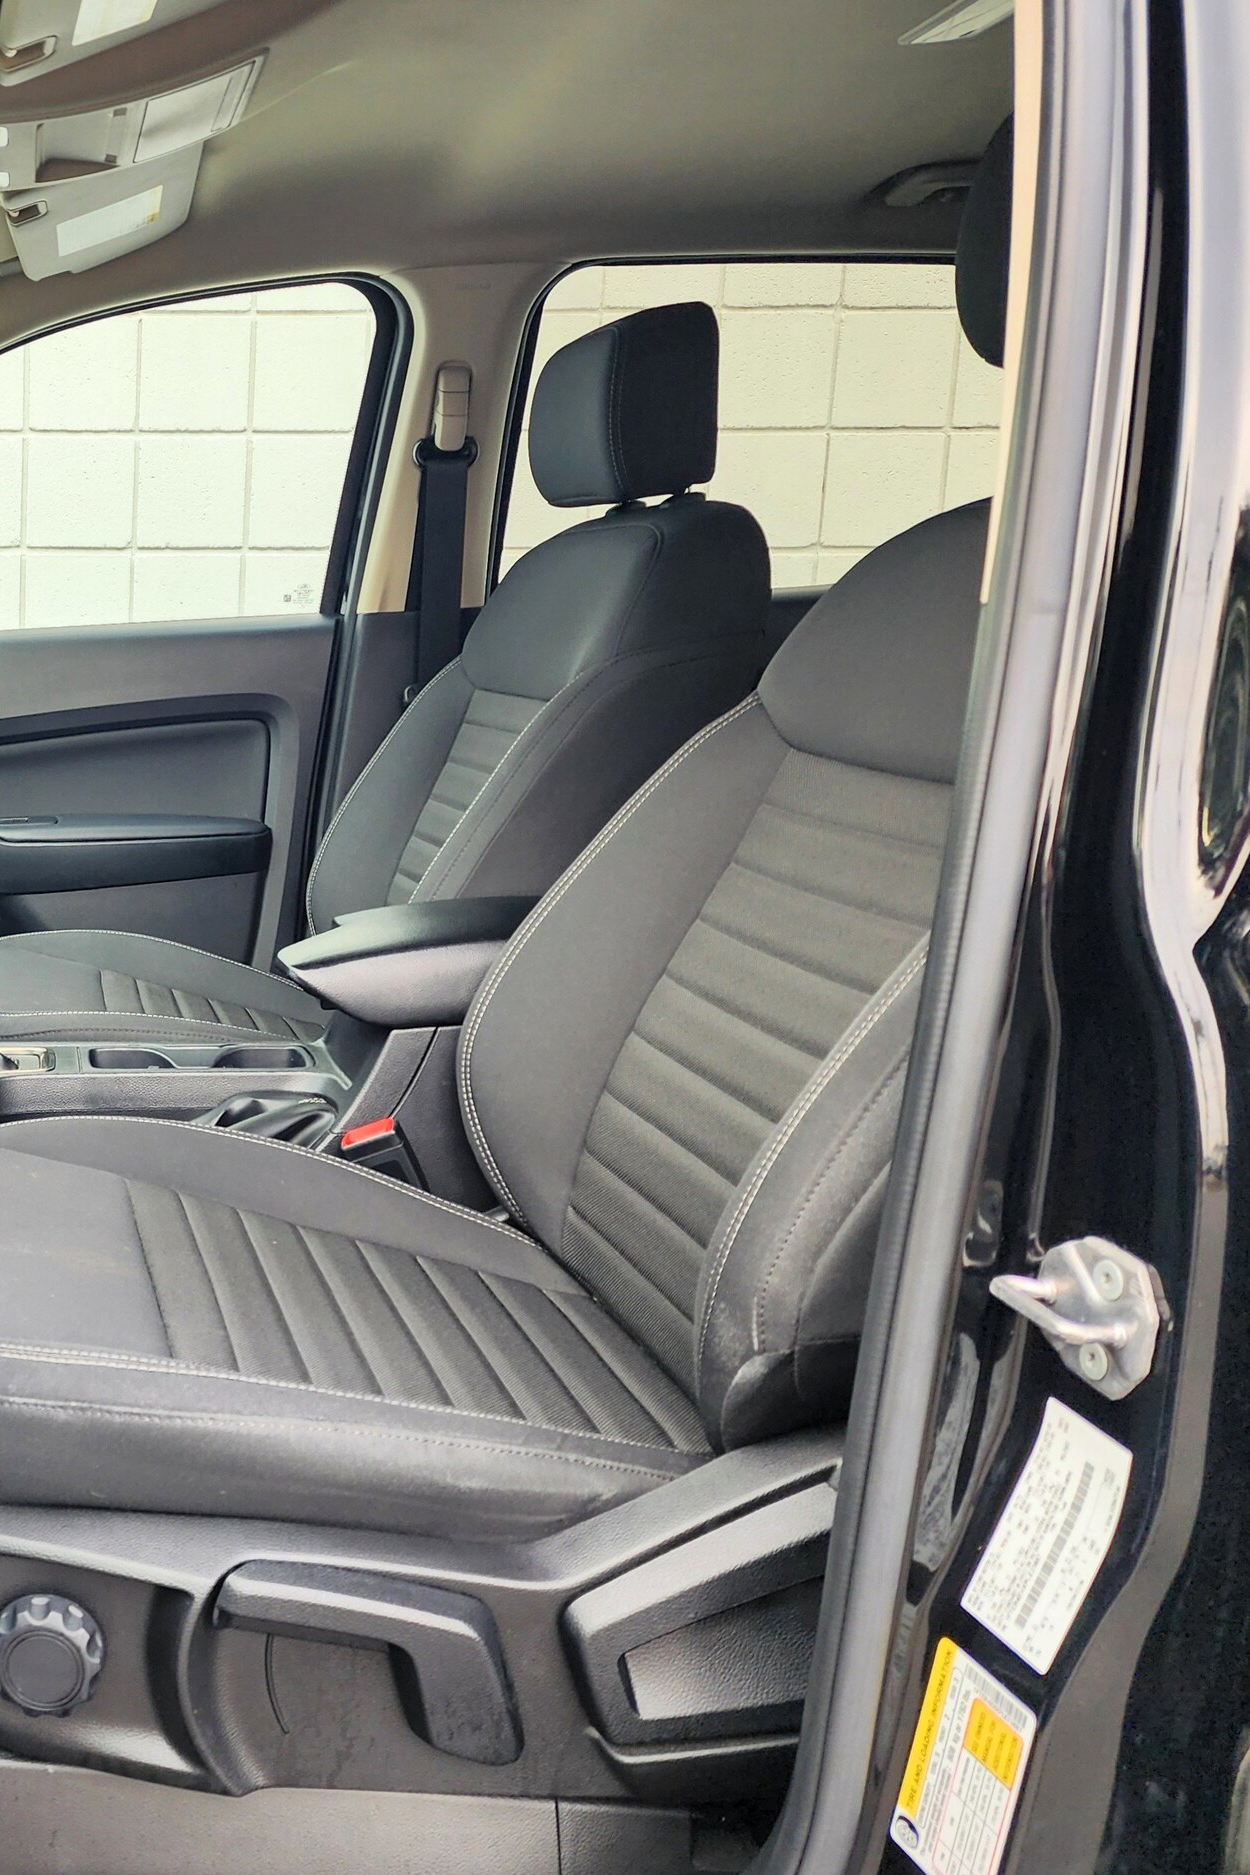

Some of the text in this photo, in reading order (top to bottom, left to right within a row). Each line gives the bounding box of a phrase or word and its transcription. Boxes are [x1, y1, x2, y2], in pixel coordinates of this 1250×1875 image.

[906, 1785, 917, 1810] TIRE
[914, 1762, 923, 1784] AND
[921, 1718, 934, 1763] LOADING
[932, 1648, 952, 1719] INFORMATION
